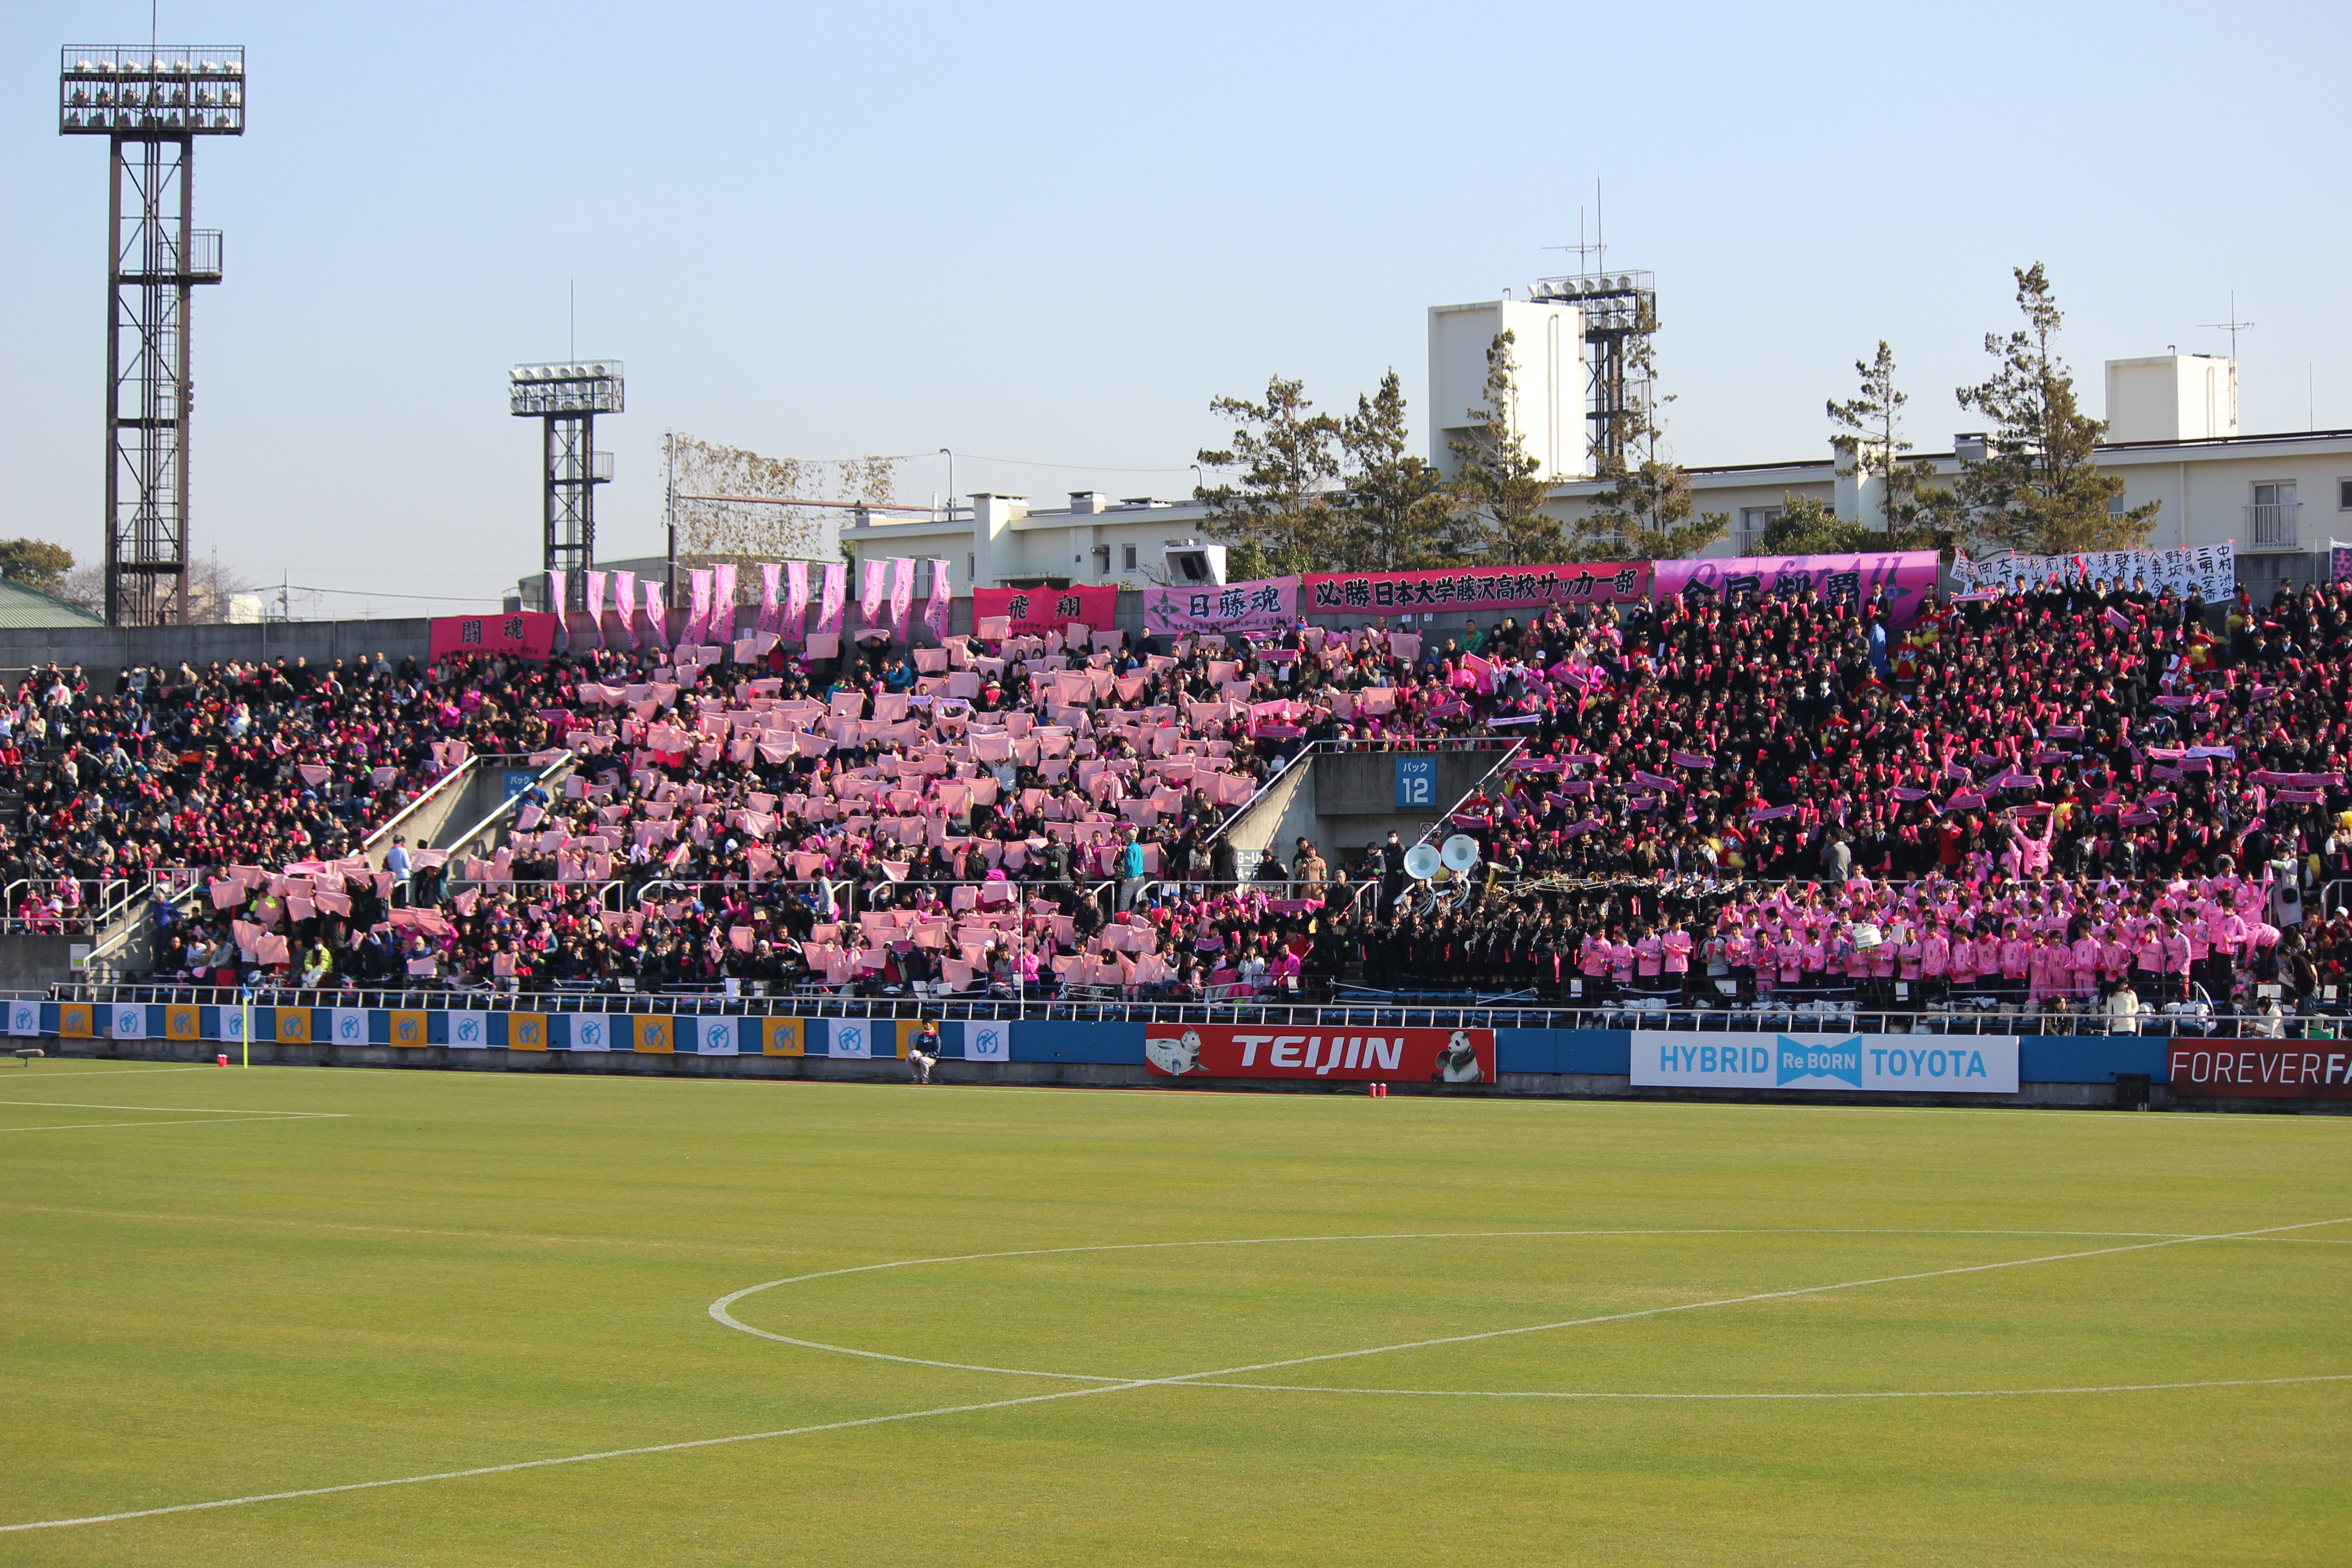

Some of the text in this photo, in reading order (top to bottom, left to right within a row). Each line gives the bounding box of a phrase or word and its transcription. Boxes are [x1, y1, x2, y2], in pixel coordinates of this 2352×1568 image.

[1978, 562, 1996, 587] 岡山
[1997, 558, 2012, 583] 大下
[2029, 558, 2042, 580] 杉山
[2098, 553, 2113, 577] 清水
[2134, 551, 2146, 577] 新井
[2165, 550, 2184, 578] 野坂
[2217, 544, 2234, 598] 中村 渋谷
[1007, 594, 1081, 620] 飛翔
[1188, 584, 1282, 619] 日藤魂
[461, 616, 524, 645] 闘魂
[510, 776, 530, 784] バック
[1403, 763, 1428, 772] バック
[1403, 778, 1428, 803] 12
[1231, 1035, 1404, 1075] TEIJIN
[1660, 1045, 1769, 1073] HYBRID
[1782, 1053, 1856, 1070] Re BORN
[1870, 1049, 1987, 1078] TOYOTA
